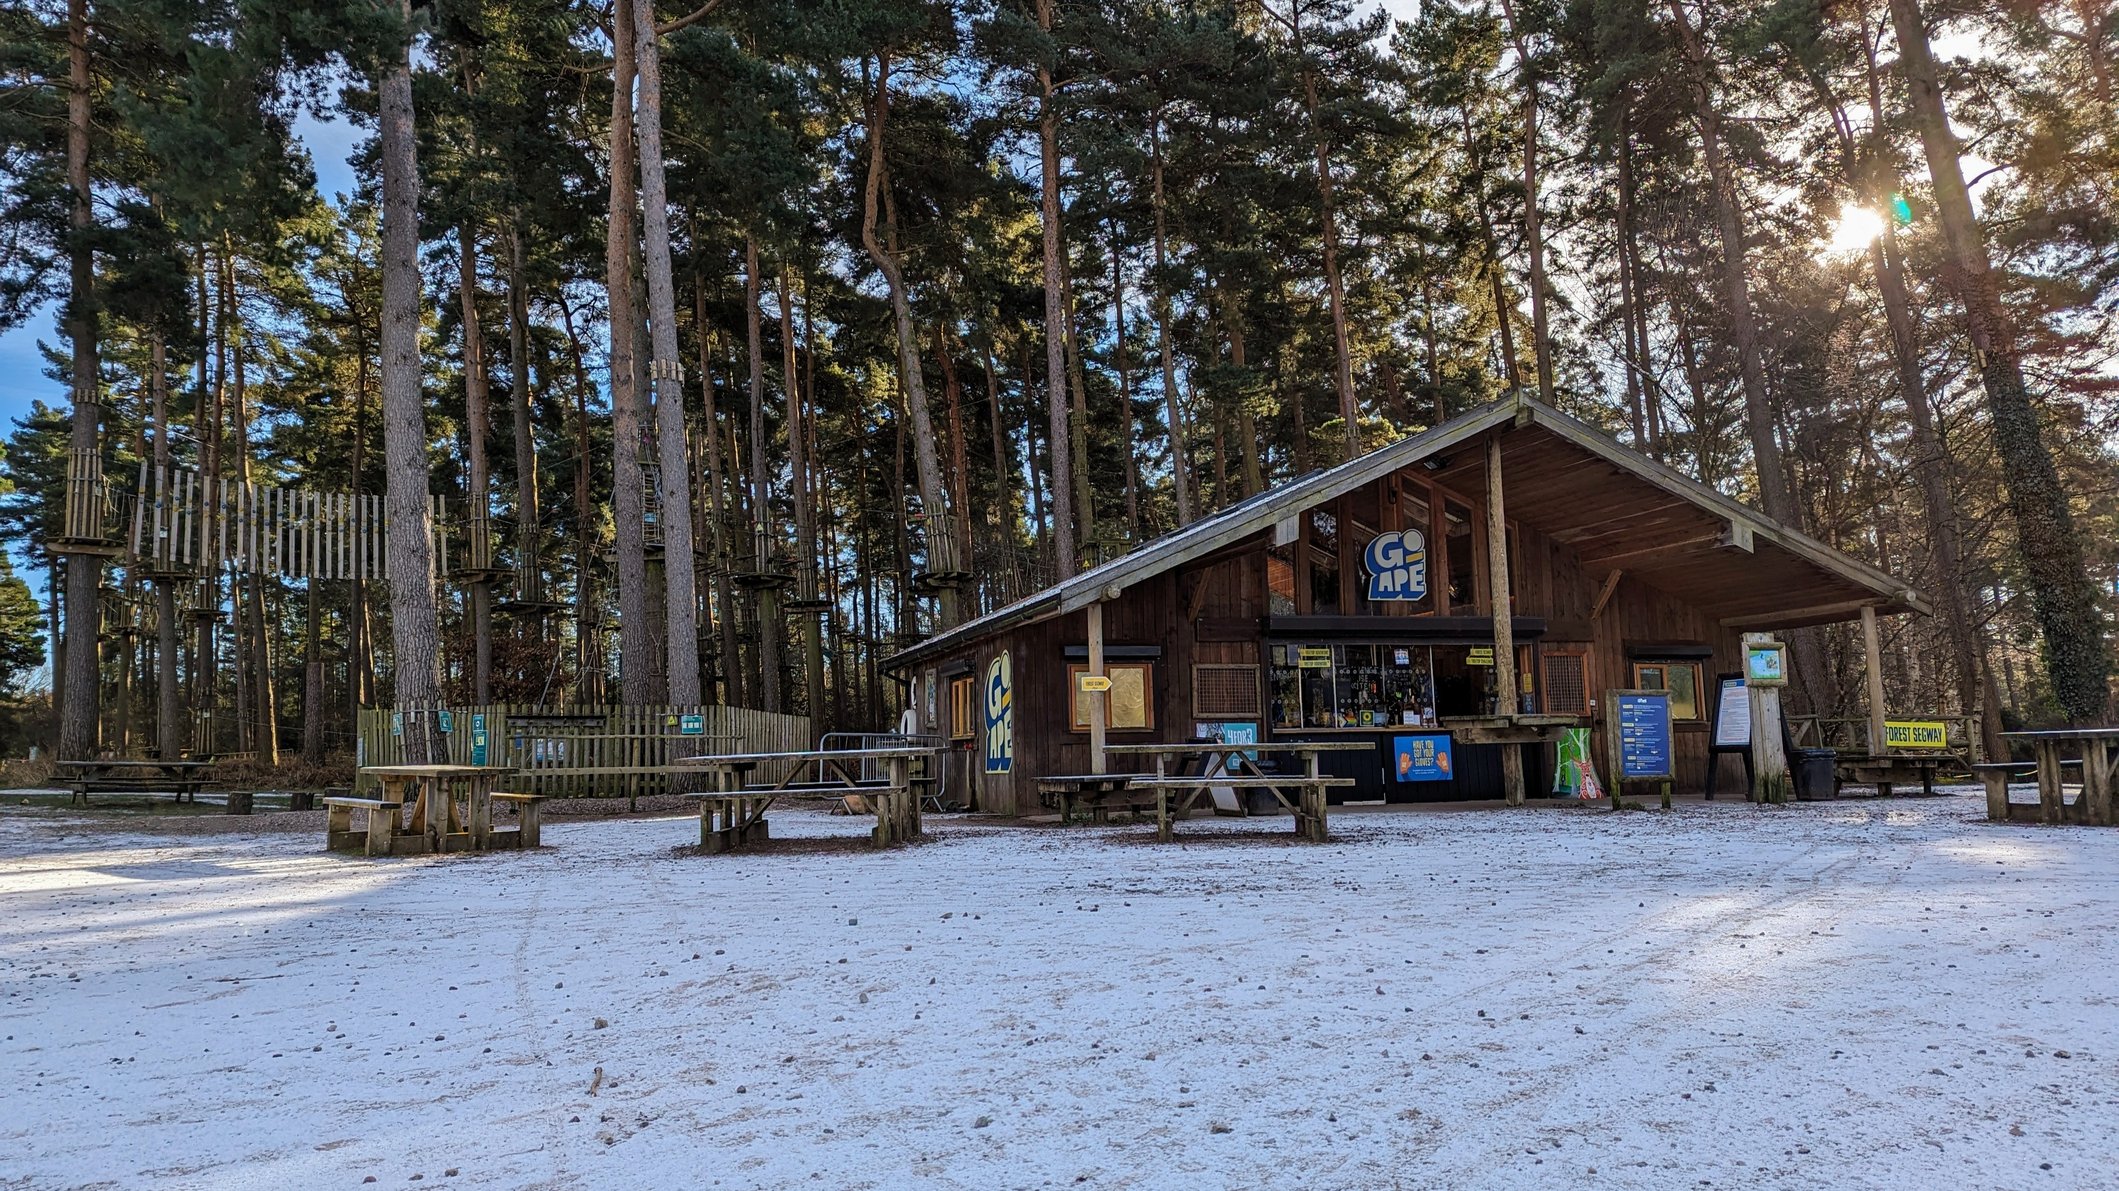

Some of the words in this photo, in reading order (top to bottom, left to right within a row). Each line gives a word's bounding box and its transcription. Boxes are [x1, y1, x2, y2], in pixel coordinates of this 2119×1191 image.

[1374, 530, 1422, 569] GO
[1378, 563, 1425, 592] APE
[988, 653, 1011, 720] GO
[989, 706, 1012, 759] APE
[1912, 727, 1942, 743] SEGWAY
